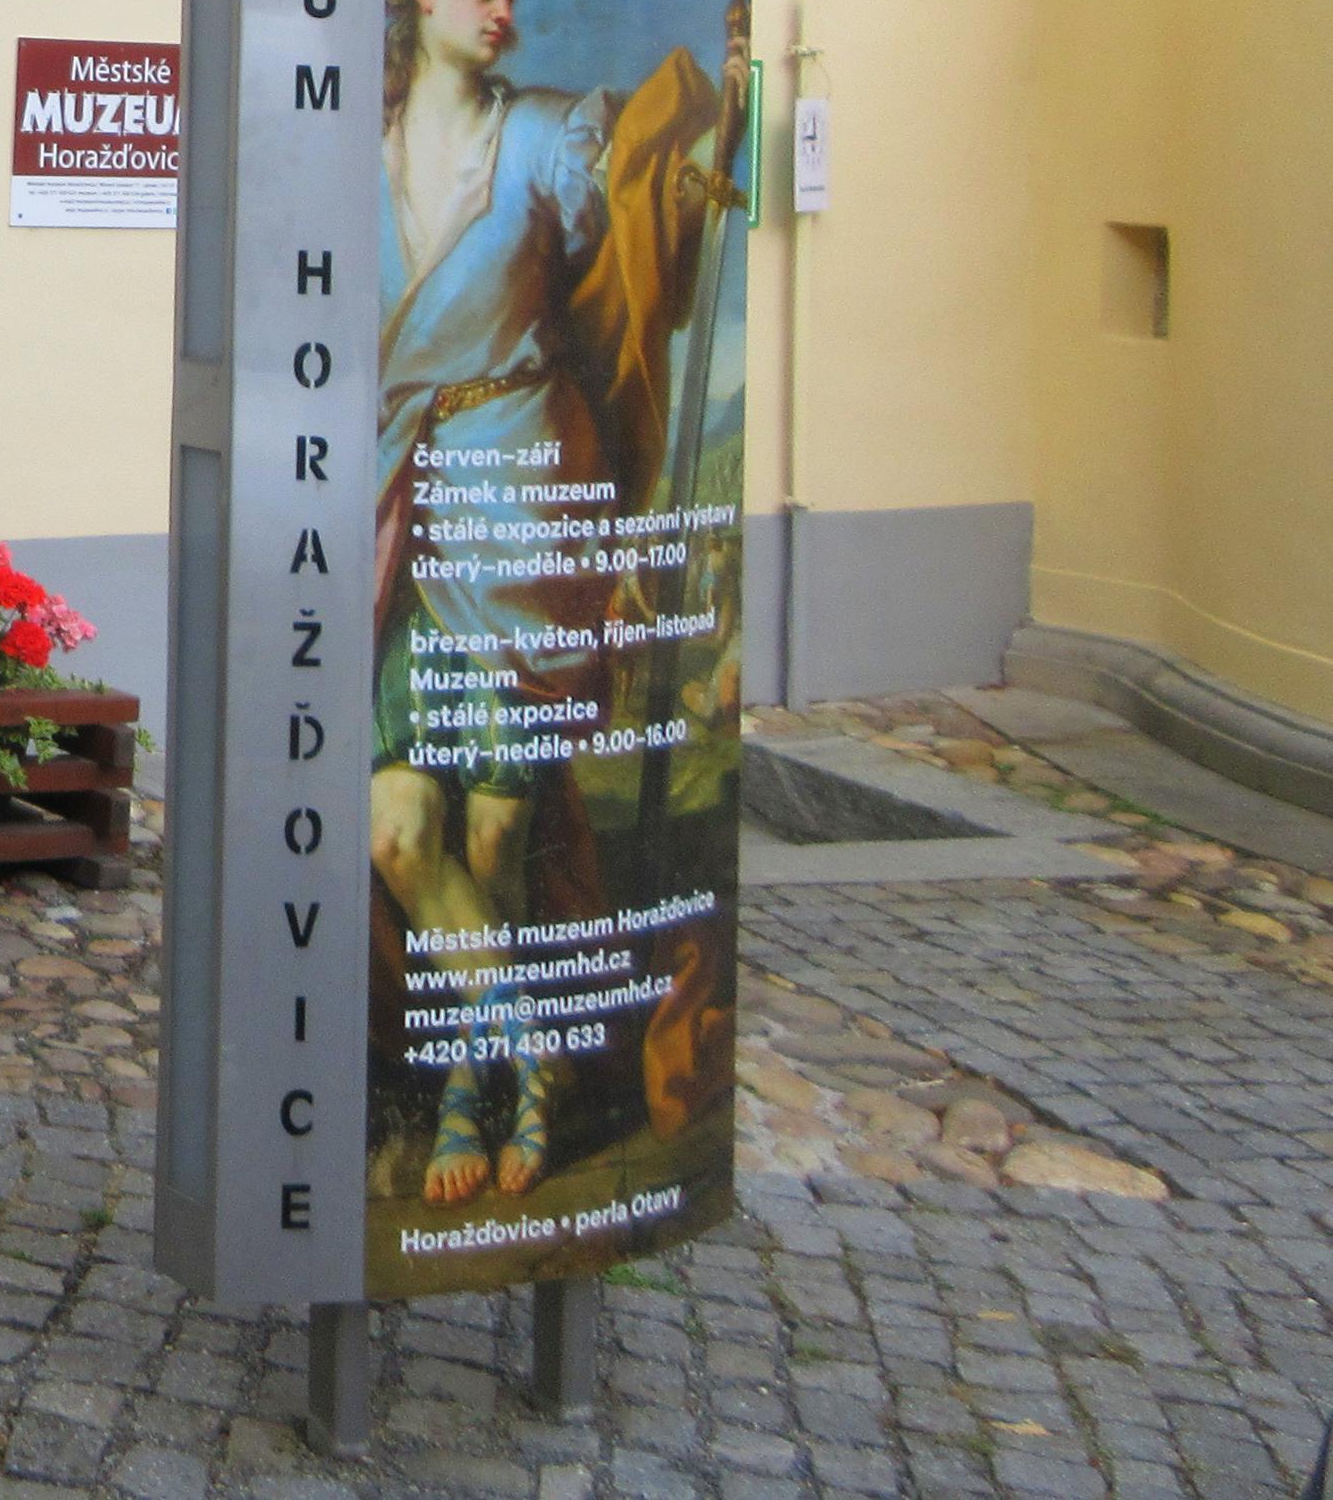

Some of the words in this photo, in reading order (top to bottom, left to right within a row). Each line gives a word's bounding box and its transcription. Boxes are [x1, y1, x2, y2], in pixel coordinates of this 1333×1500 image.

[71, 56, 170, 84] Městské
[21, 90, 180, 135] MUZEU
[414, 482, 498, 505] Zámek
[503, 488, 514, 503] a
[521, 481, 615, 502] muzeum
[429, 518, 487, 541] stálé
[494, 515, 594, 544] expozice
[599, 521, 610, 536] a
[615, 509, 681, 532] sezónní
[683, 504, 736, 530] výstavy
[410, 668, 519, 691] Muzeum
[427, 703, 488, 727] stálé
[494, 698, 599, 730] expozice
[277, 248, 334, 1231] HORAŽĎOVICE
[406, 925, 511, 954] Městské
[518, 917, 613, 944] muzeum
[617, 890, 714, 931] Horažďovice
[405, 948, 631, 991] www.muzeumhd.cz
[405, 974, 672, 1029] muzeum@muzeumhd.cz
[405, 1036, 466, 1065] +420
[474, 1032, 509, 1058] 371
[518, 1028, 561, 1055] 430
[566, 1023, 605, 1050] 633
[400, 1215, 556, 1252] Horažďovice
[576, 1203, 627, 1236] perla
[632, 1184, 682, 1219] Otavy
